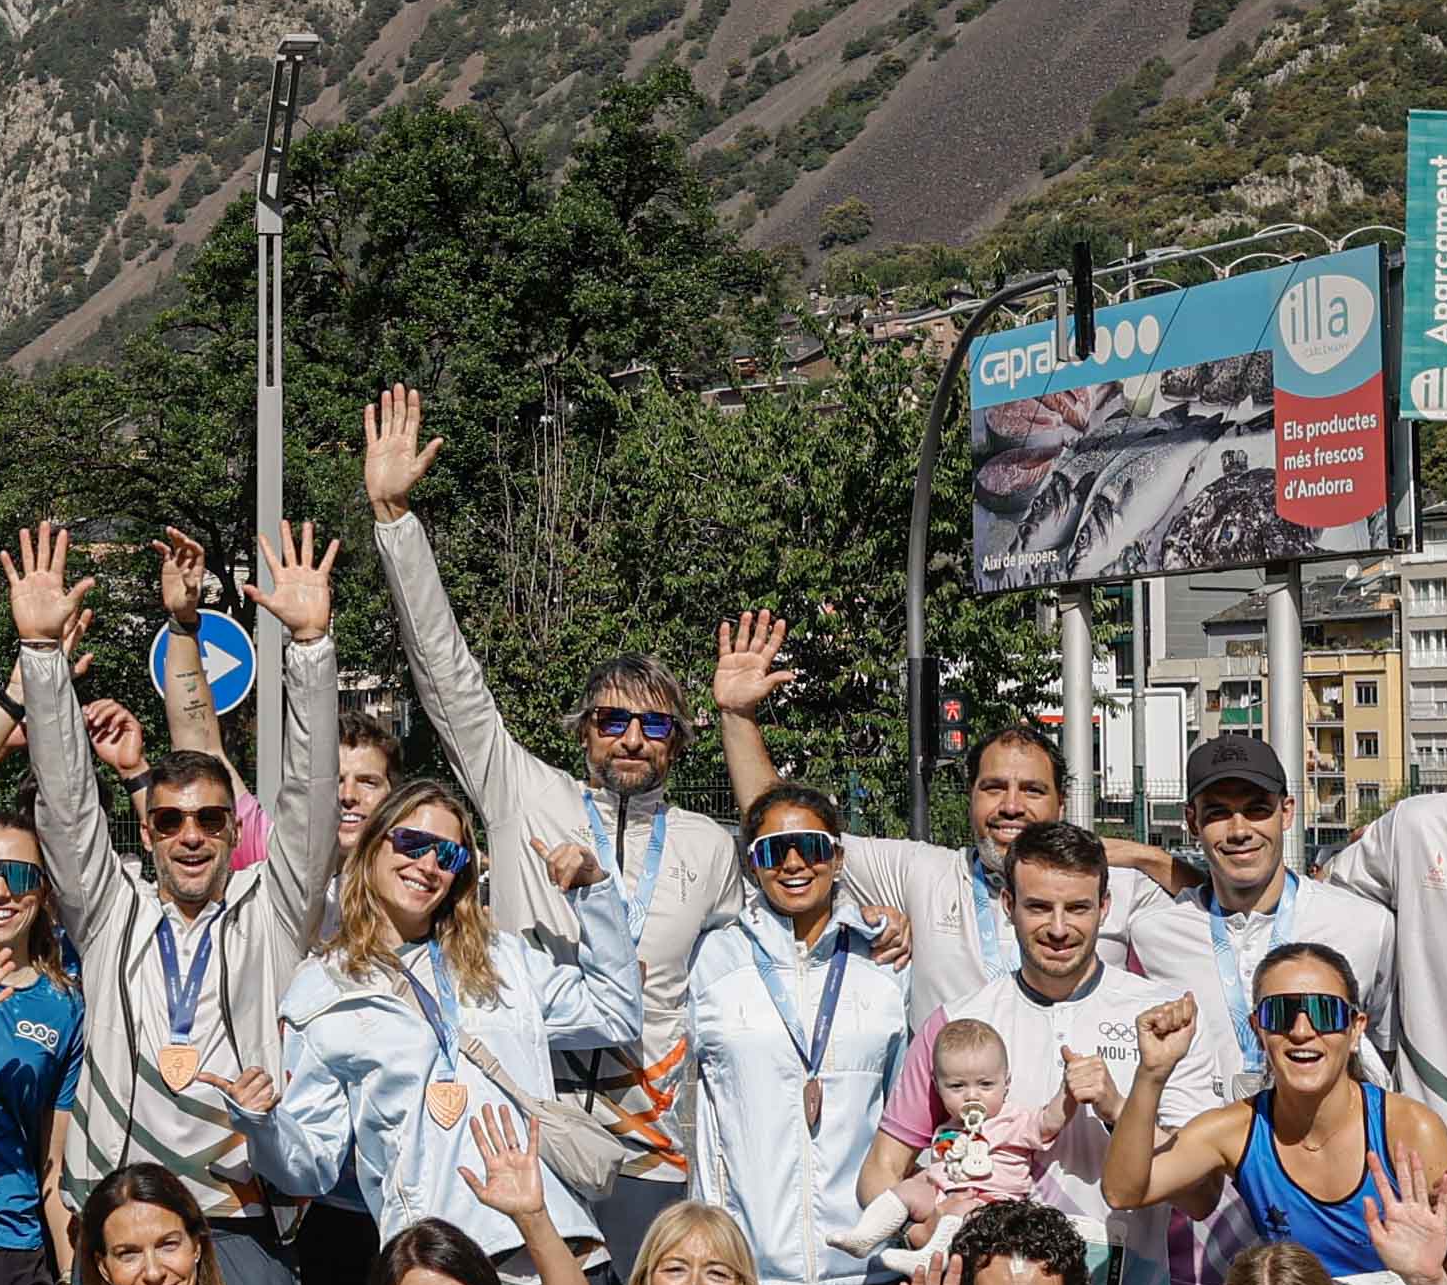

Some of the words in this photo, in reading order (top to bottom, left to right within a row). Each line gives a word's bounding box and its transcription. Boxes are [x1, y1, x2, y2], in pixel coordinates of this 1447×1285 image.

[1290, 276, 1349, 345] illa
[1283, 421, 1305, 441] Els
[1306, 413, 1377, 440] productes
[1284, 449, 1312, 471] més
[1314, 445, 1364, 467] frescos
[1284, 477, 1354, 500] d'Andorra
[1003, 551, 1017, 567] de
[1097, 1045, 1139, 1061] MOU-T
